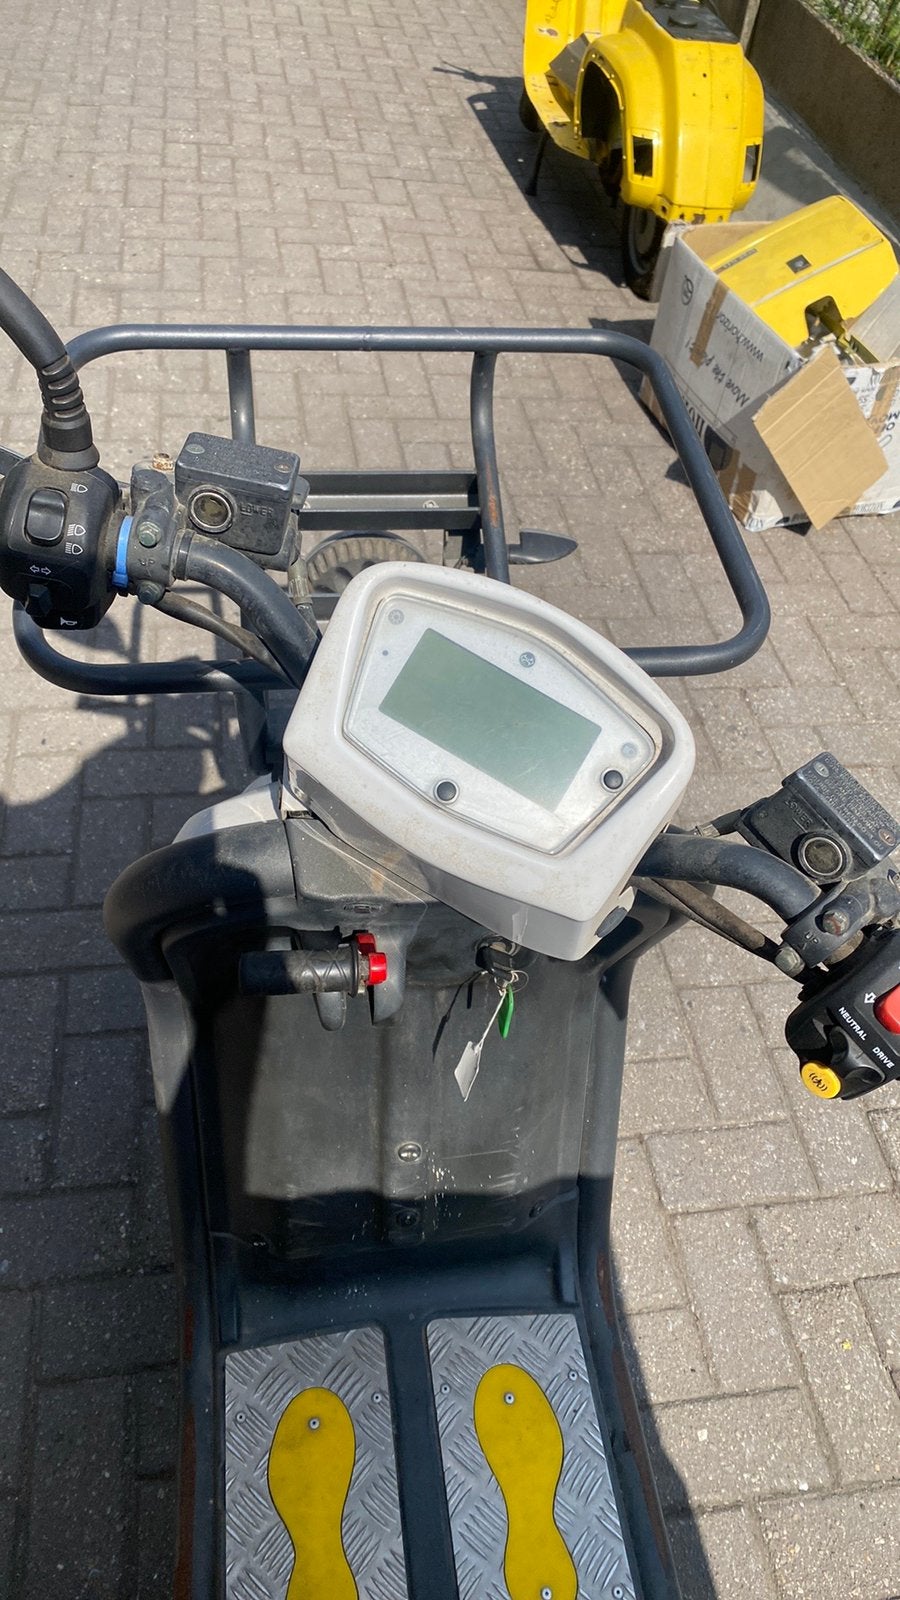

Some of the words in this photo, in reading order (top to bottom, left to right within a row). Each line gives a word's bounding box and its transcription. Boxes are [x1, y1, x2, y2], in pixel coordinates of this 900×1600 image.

[725, 379, 751, 407] Move
[240, 502, 274, 517] LOWER
[138, 557, 156, 567] UP
[804, 930, 819, 944] UP
[838, 1006, 868, 1041] NEUTRAL
[872, 1046, 895, 1069] DRIVE
